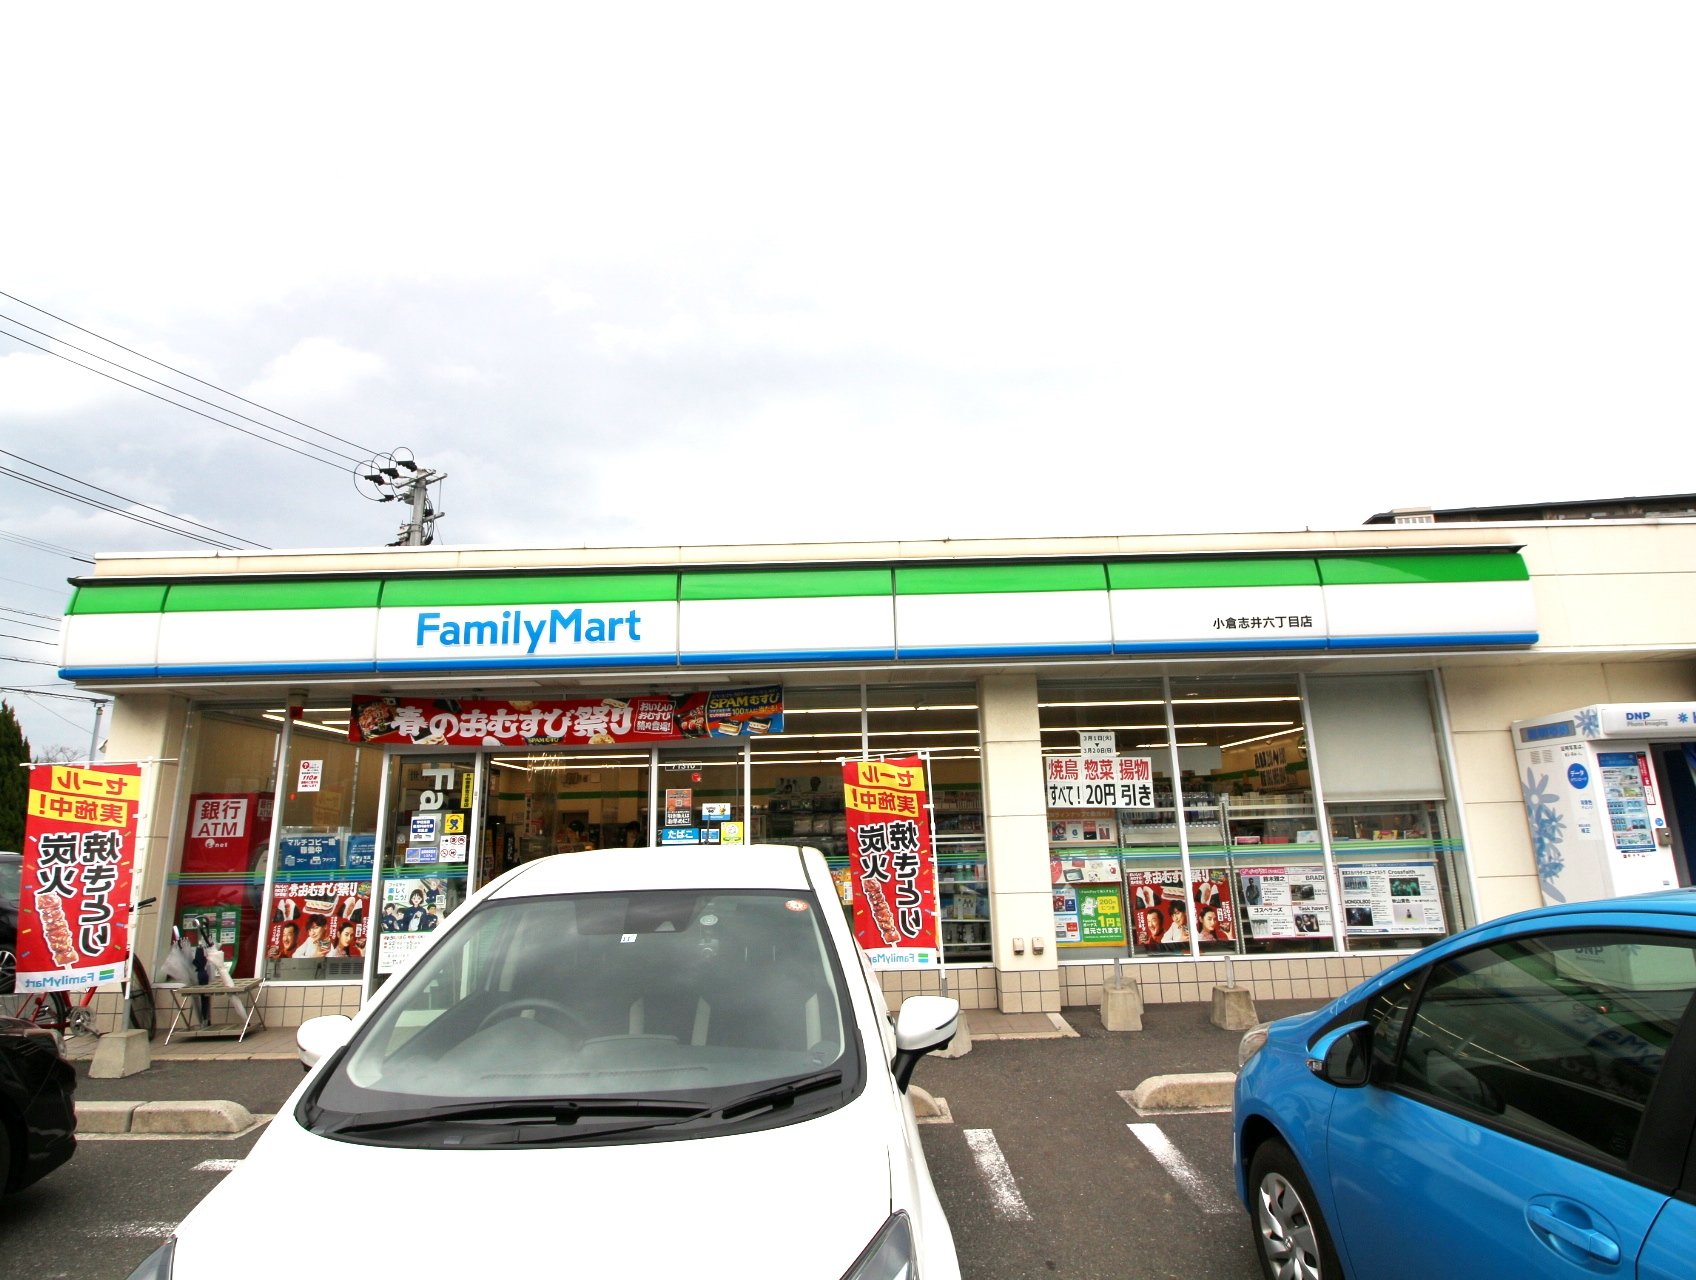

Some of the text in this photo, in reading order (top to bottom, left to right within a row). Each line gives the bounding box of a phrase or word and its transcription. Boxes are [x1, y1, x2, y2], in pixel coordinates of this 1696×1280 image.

[1213, 615, 1312, 630] 小倉志井六丁目店
[416, 609, 641, 653] FamilyMart
[639, 701, 673, 711] おいしい
[709, 692, 779, 710] SPAMむすび
[390, 704, 633, 738] 春のおむすび祭り
[638, 711, 671, 721] おむすび
[1626, 711, 1650, 721] DNP
[1048, 759, 1149, 781] 焼鳥 惣菜 揚物
[1049, 784, 1152, 806] すべて! 20円 引き
[201, 800, 241, 820] 銀行
[198, 822, 238, 836] ATM
[667, 829, 694, 839] たばこ
